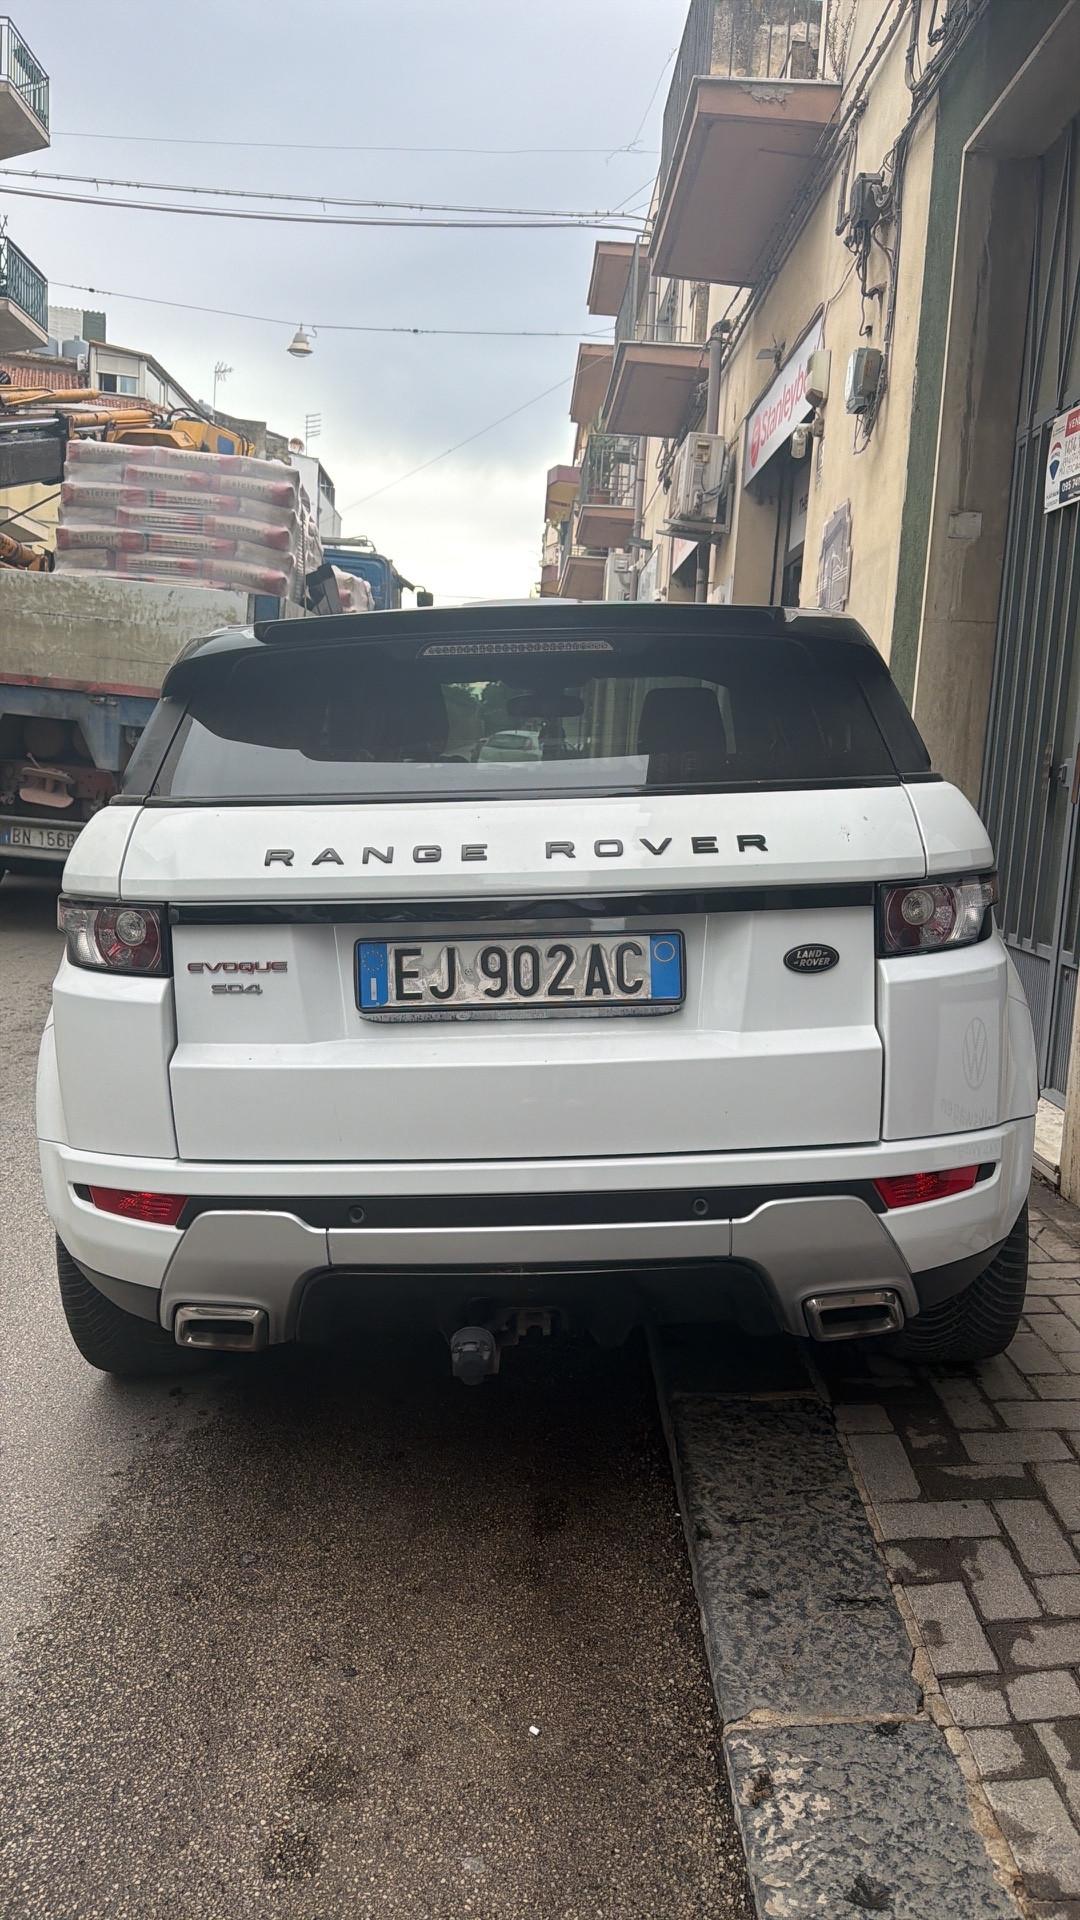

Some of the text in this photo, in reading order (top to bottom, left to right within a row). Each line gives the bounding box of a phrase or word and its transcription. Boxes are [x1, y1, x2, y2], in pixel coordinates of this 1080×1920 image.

[12, 827, 31, 845] BN
[40, 831, 79, 849] 156B
[264, 834, 769, 866] RANGE ROVER
[796, 949, 822, 959] LAND
[187, 961, 288, 974] EVOQUE
[800, 957, 831, 967] ROVER
[395, 946, 456, 1001] EJ
[480, 941, 644, 998] 902AC
[211, 983, 263, 996] SD4
